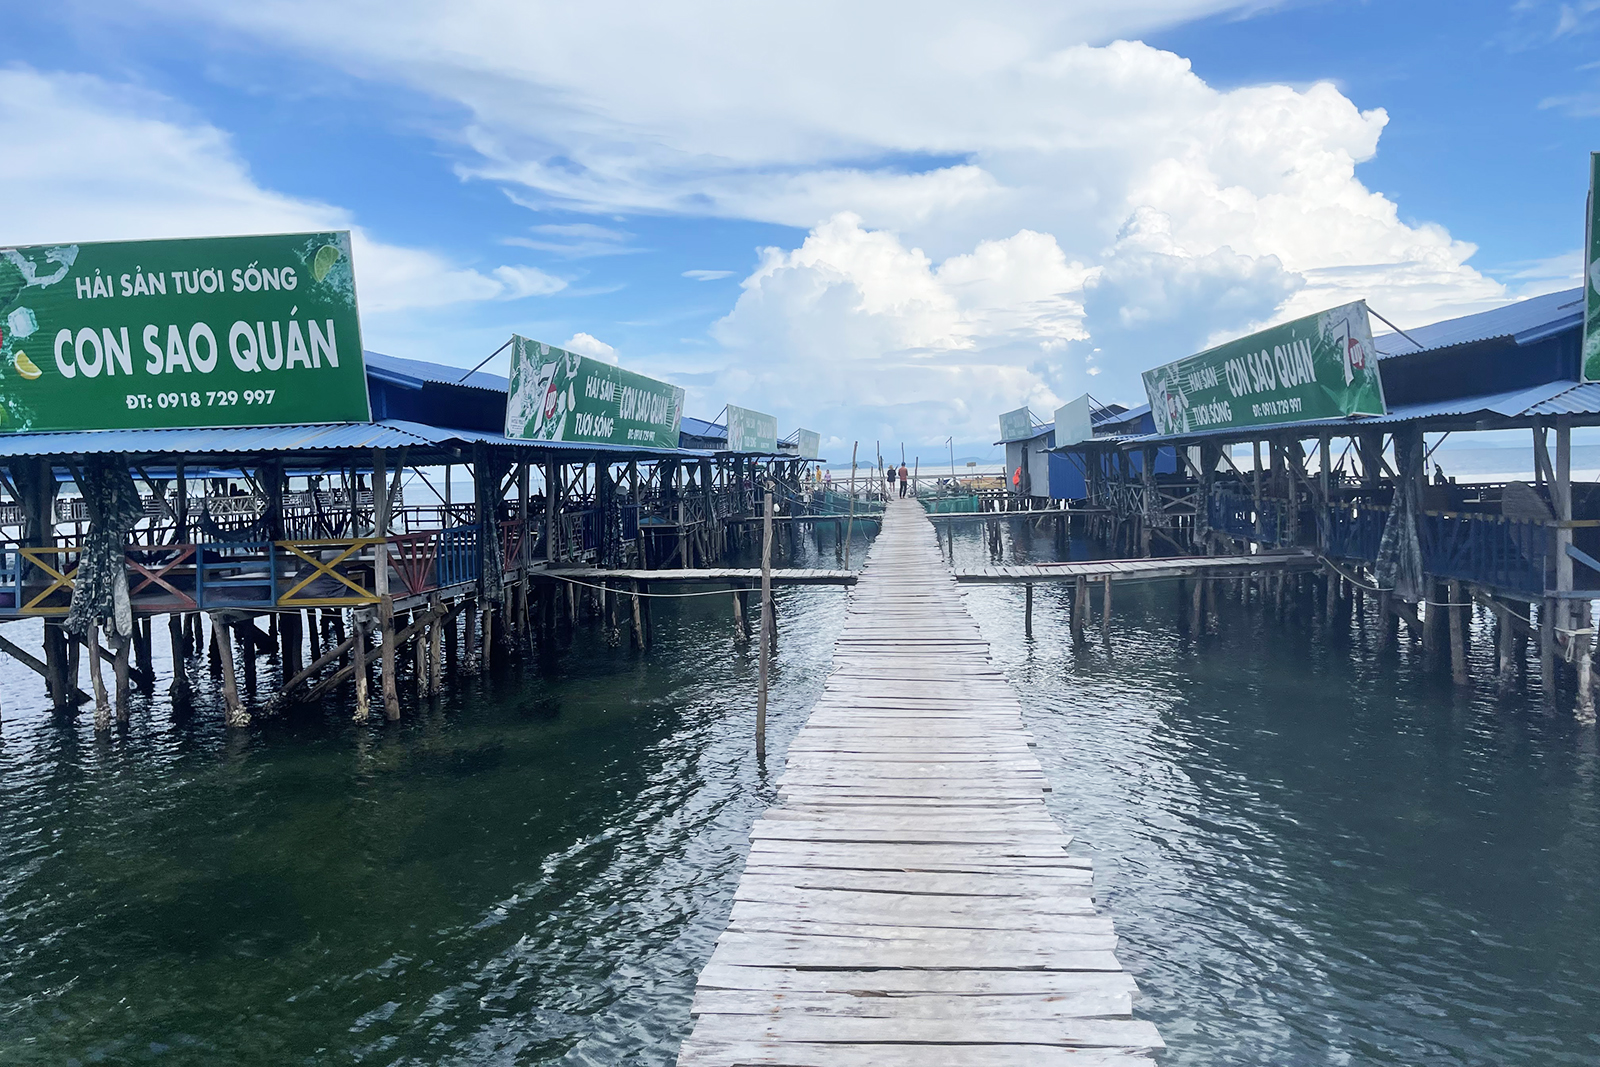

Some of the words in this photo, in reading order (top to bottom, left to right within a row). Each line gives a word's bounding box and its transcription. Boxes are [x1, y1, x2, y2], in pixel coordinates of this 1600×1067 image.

[75, 268, 114, 299] HẢI
[120, 265, 166, 297] SẢN
[171, 267, 225, 294] TƯƠI
[232, 261, 298, 292] SỐNG
[54, 326, 133, 379] CON
[142, 321, 219, 375] SAO
[228, 306, 340, 373] QUÁN
[1224, 357, 1252, 398] CON
[1247, 349, 1277, 393] SAO
[1274, 328, 1317, 388] QUÁN
[126, 393, 153, 410] ĐT:
[157, 391, 201, 408] 0918
[206, 390, 238, 406] 729
[243, 389, 276, 405] 997
[585, 370, 601, 399] HẢI
[600, 374, 616, 402] SẢN
[619, 386, 638, 420] CON
[635, 389, 651, 423] SAO
[1192, 404, 1211, 425] TƯƠI
[1209, 396, 1232, 423] SỐNG
[1276, 399, 1290, 414] 729
[1289, 397, 1302, 413] 997
[574, 411, 593, 436] TƯƠI
[592, 410, 614, 438] SỐNG
